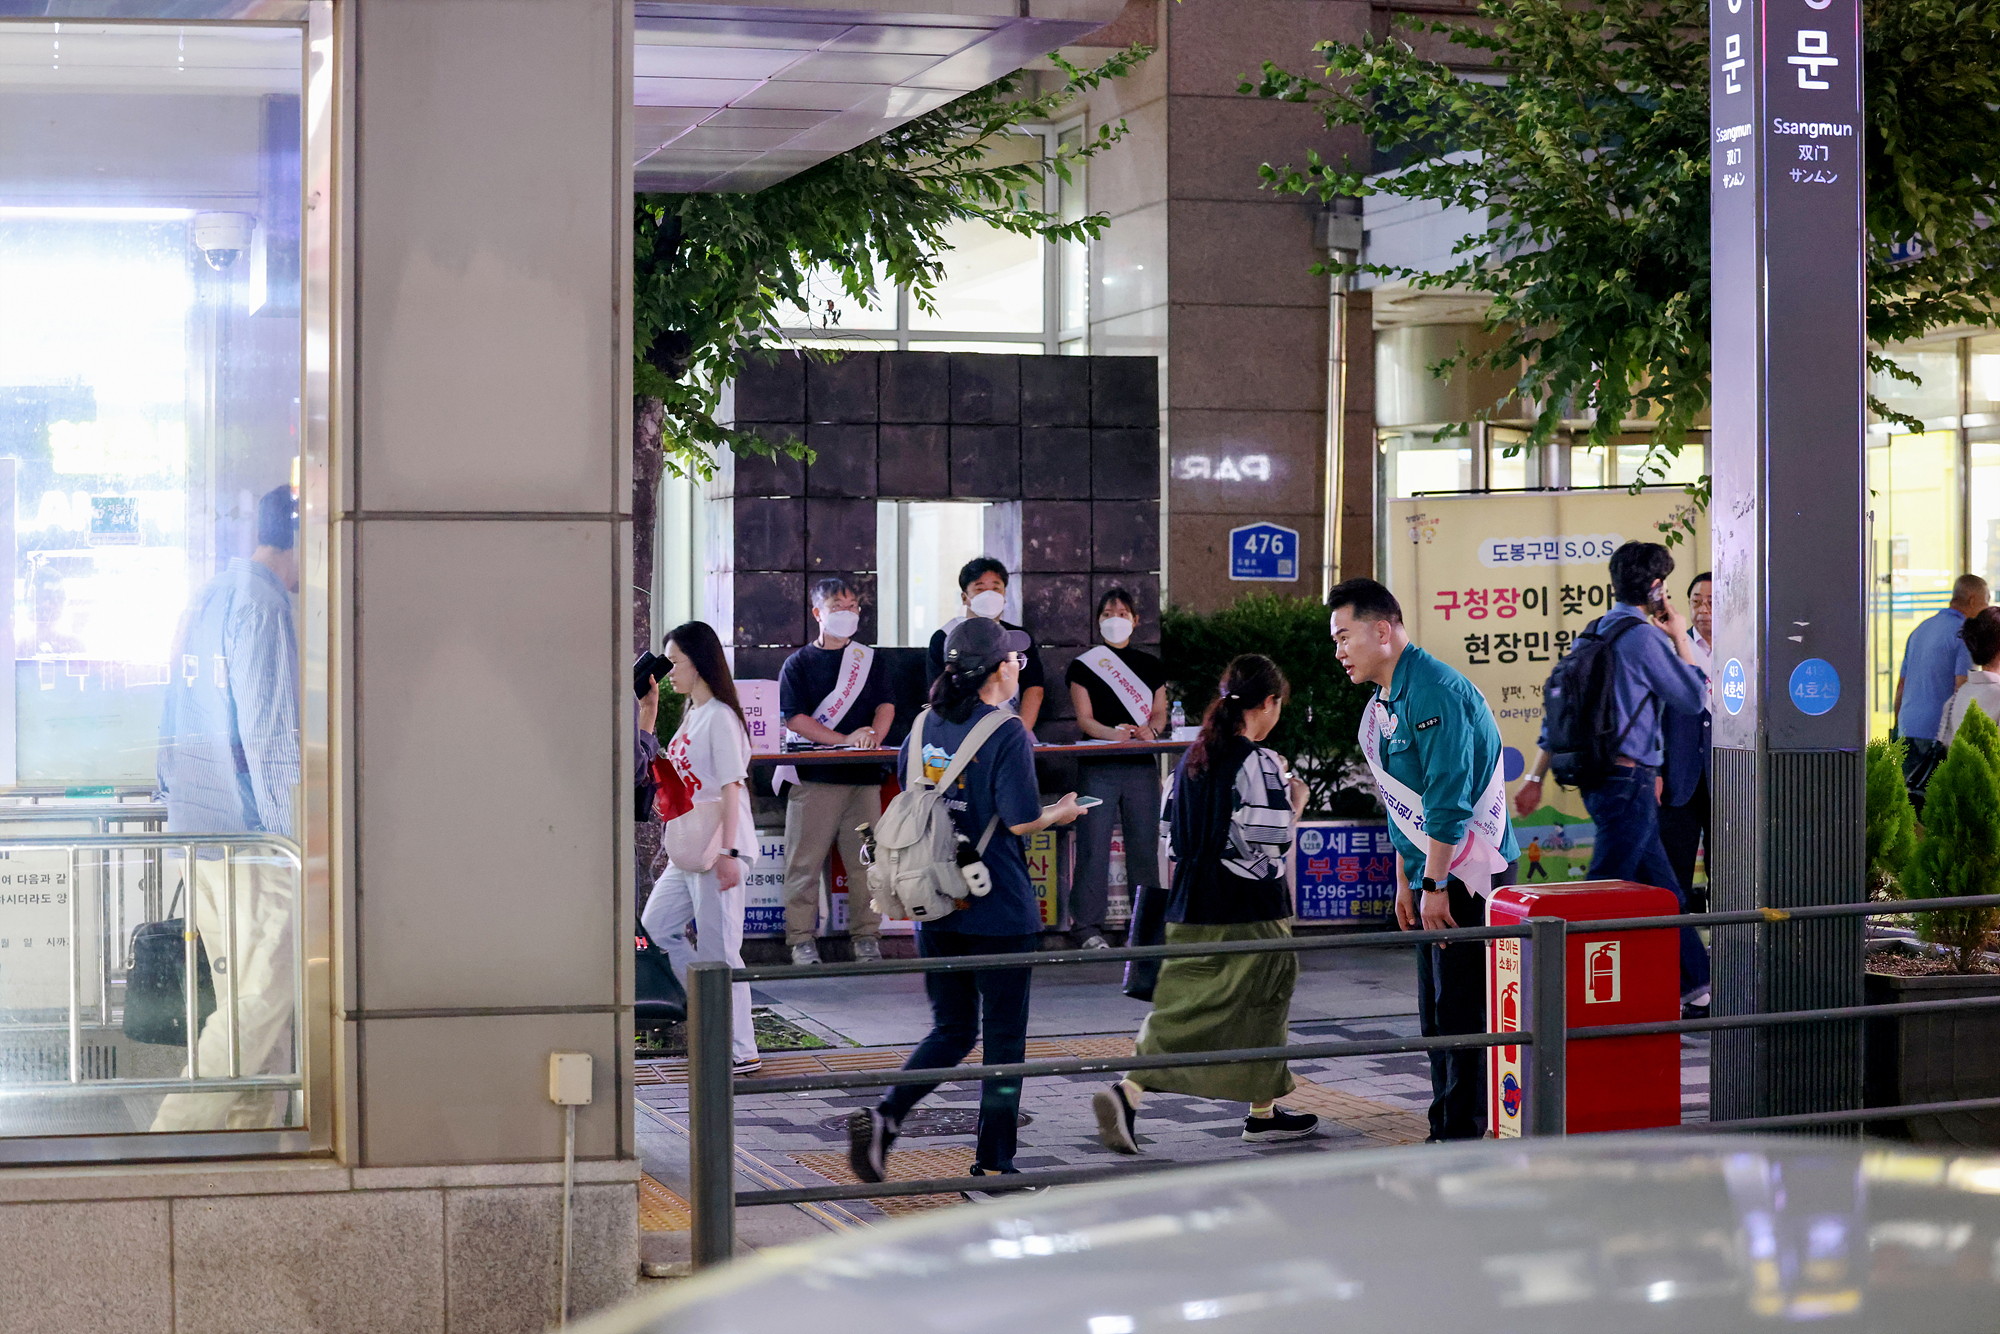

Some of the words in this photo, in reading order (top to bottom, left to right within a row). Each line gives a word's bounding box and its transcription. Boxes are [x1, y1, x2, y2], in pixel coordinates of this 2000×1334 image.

[1715, 123, 1751, 143] Ssangmun
[1773, 118, 1852, 138] Ssangmun
[1726, 148, 1741, 166] 双门
[1798, 145, 1829, 162] 双门
[1789, 168, 1838, 184] サンムン
[1244, 534, 1284, 555] 476
[1493, 542, 1559, 561] 도봉구민
[1434, 586, 1548, 621] 구청장이
[1560, 584, 1617, 616] 찾아
[1728, 665, 1739, 677] 413
[1805, 666, 1825, 677] 413
[1724, 681, 1744, 699] 4호선
[1795, 681, 1836, 699] 4호선
[741, 706, 762, 717] 구민
[1305, 856, 1393, 882] 부동산
[17, 873, 51, 885] 다음과
[1302, 884, 1395, 899] T.996-5114
[46, 937, 69, 947] 시까
[1499, 938, 1519, 955] 보이는
[1499, 956, 1519, 974] 소화기
